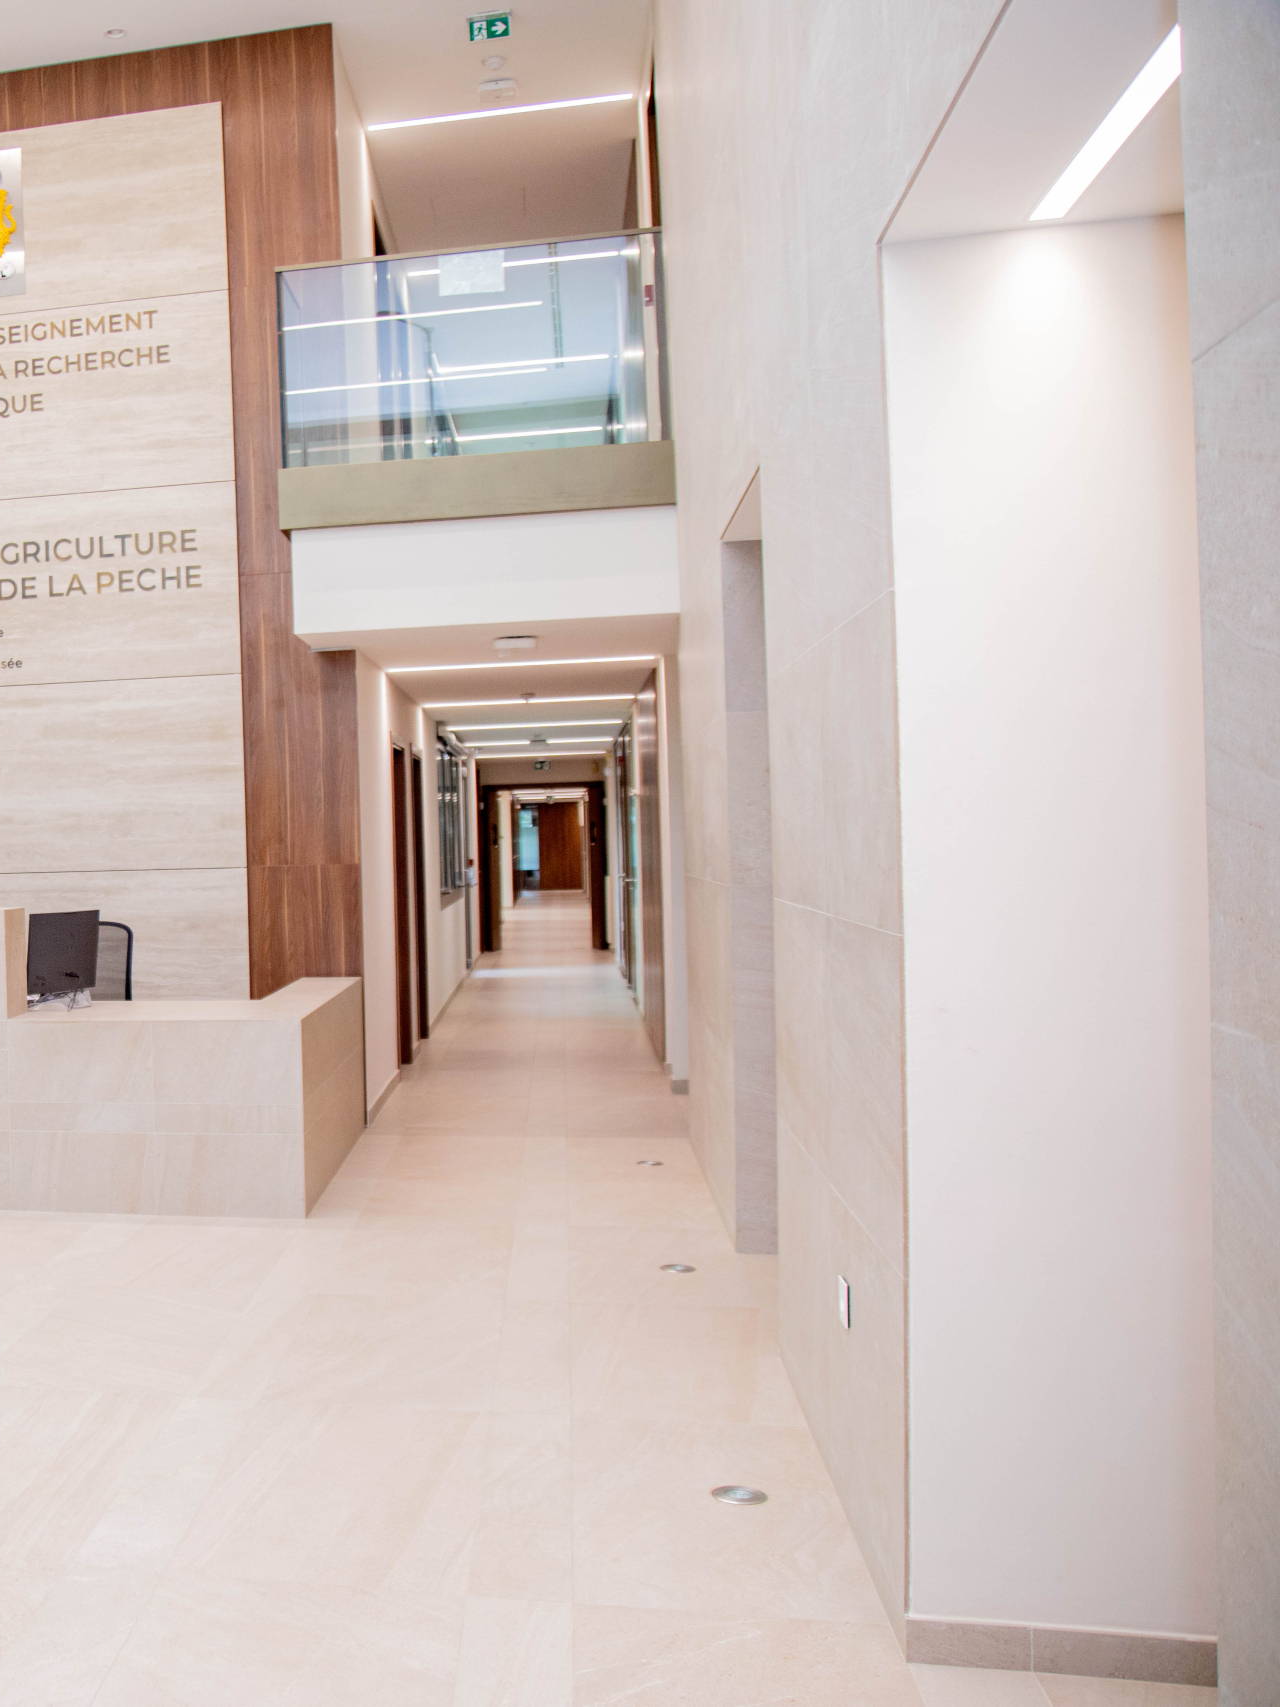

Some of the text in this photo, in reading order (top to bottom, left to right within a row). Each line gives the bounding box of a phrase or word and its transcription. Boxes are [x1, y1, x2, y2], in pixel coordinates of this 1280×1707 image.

[14, 344, 170, 379] RECHERCHE
[48, 573, 87, 598] LA
[96, 565, 203, 595] PECHE
